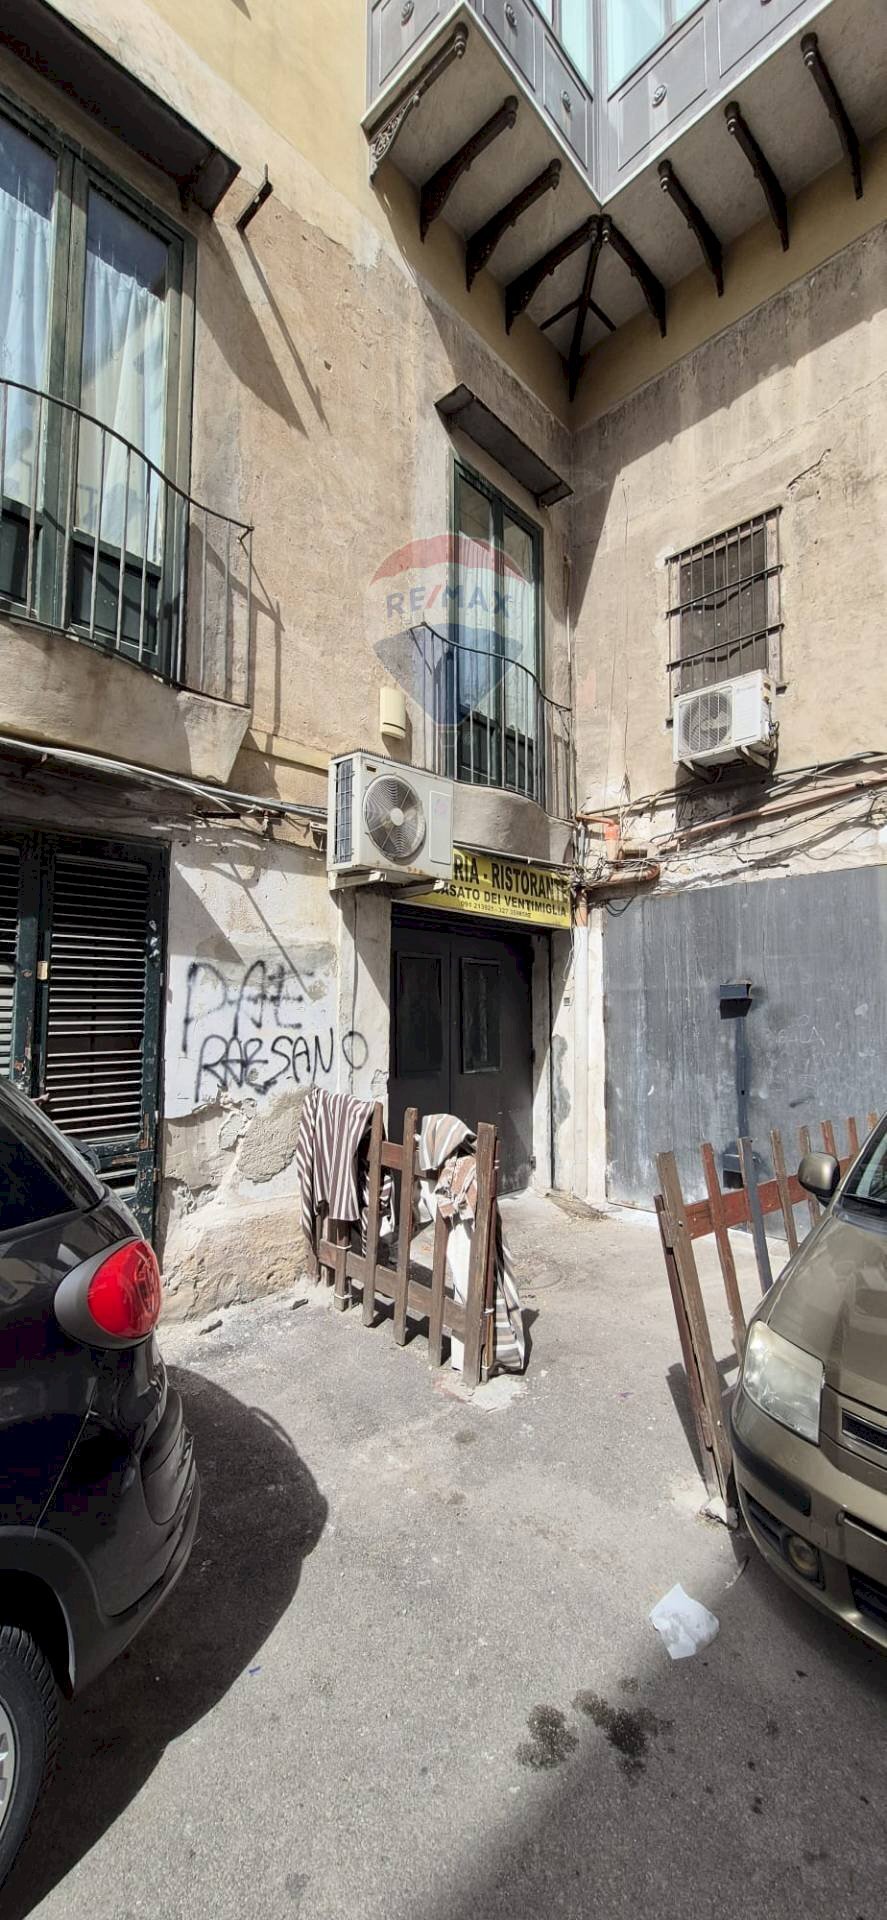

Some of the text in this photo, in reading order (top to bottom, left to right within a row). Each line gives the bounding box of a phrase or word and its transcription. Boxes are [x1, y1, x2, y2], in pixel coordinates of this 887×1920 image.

[433, 884, 480, 901] ASATO
[484, 891, 501, 905] DEI
[504, 894, 567, 917] VENTIMIGLIA
